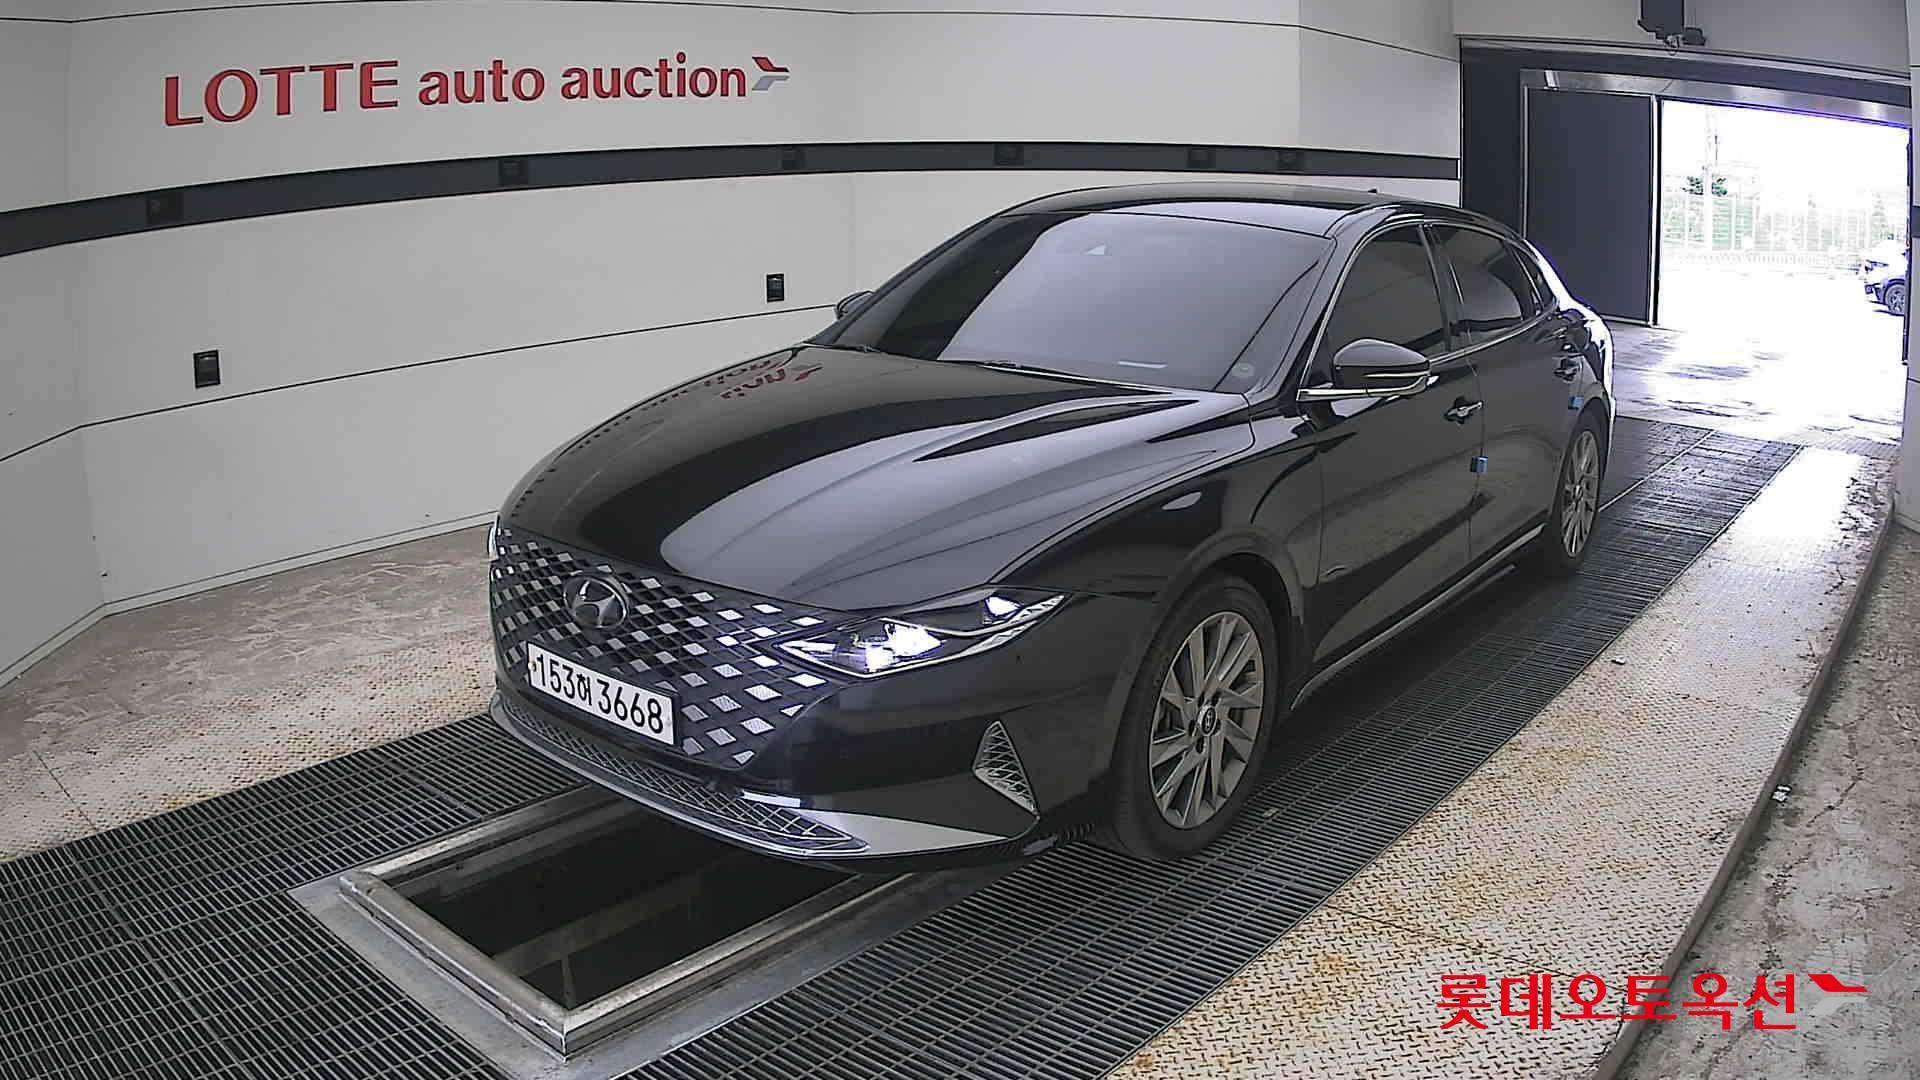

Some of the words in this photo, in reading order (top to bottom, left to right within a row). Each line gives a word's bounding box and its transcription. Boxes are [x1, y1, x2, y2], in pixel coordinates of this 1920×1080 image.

[164, 60, 399, 126] LOTTE
[418, 59, 545, 105] auto
[561, 52, 747, 99] auction
[537, 654, 592, 706] 153허
[597, 680, 664, 734] 3668
